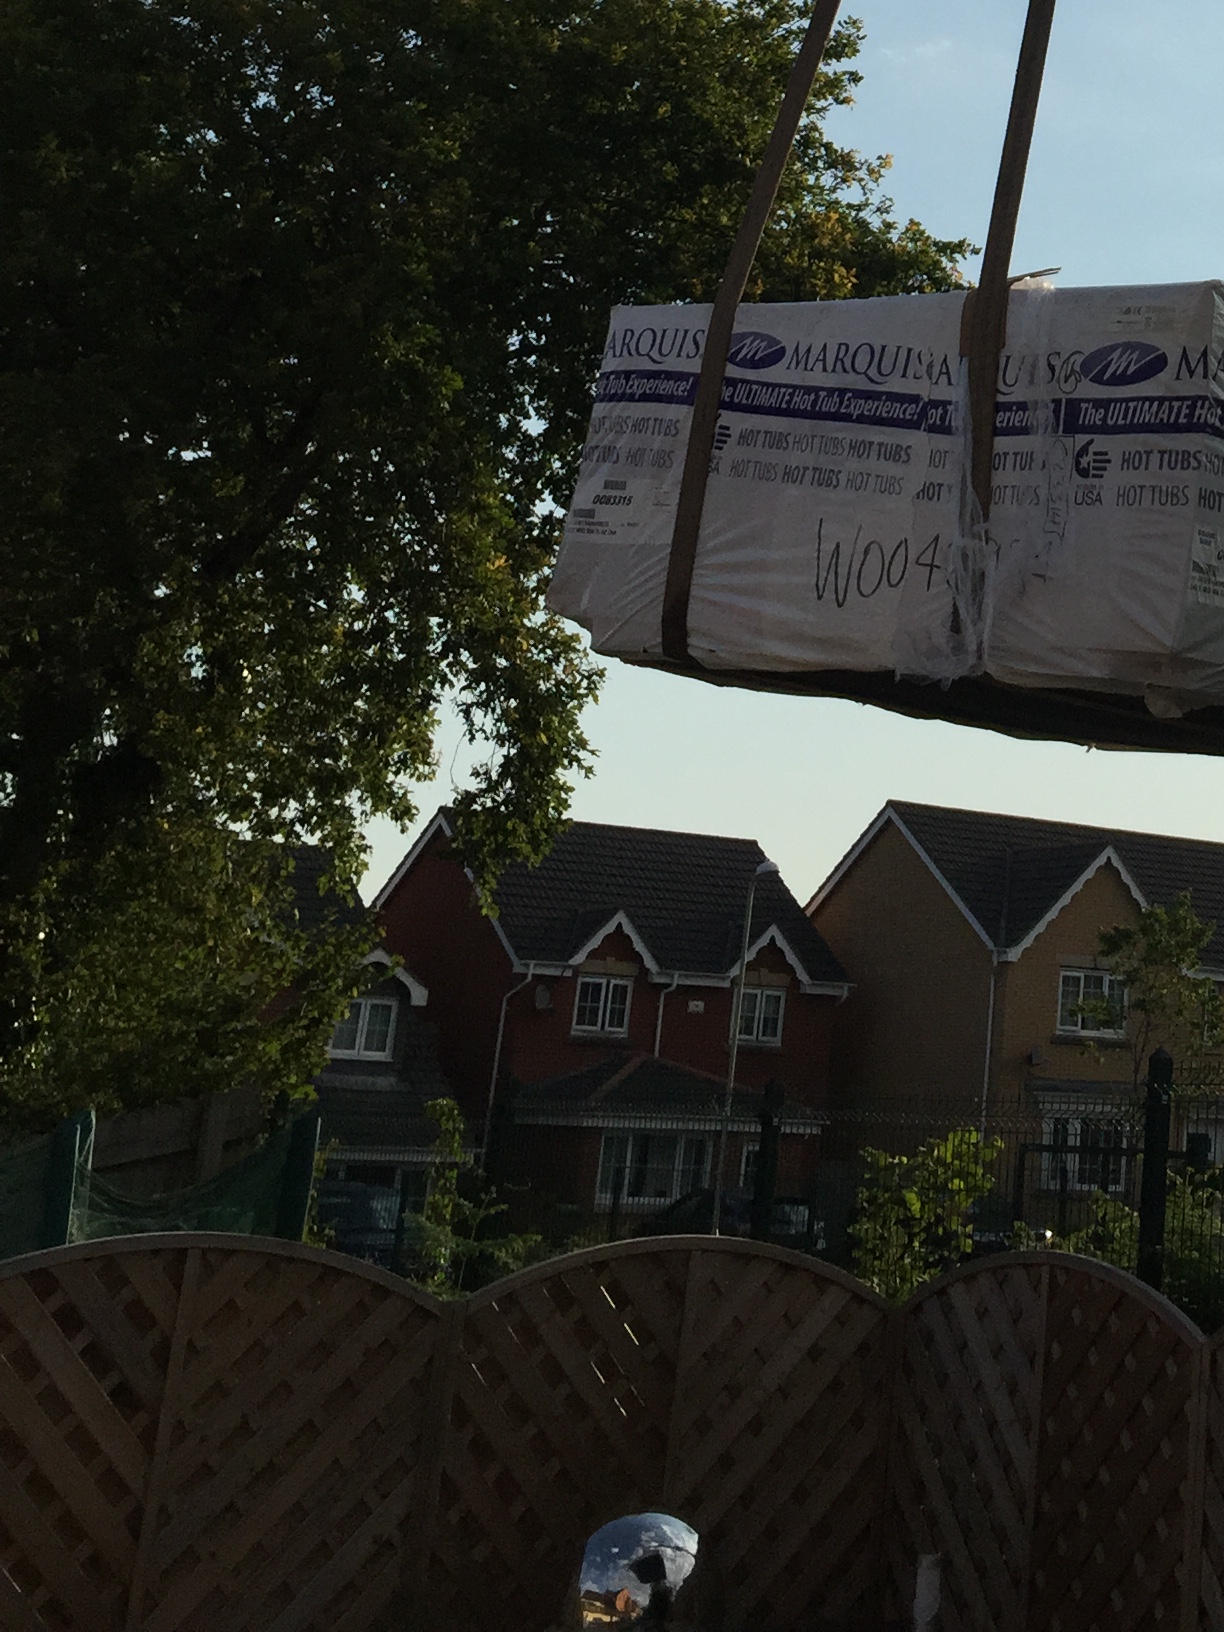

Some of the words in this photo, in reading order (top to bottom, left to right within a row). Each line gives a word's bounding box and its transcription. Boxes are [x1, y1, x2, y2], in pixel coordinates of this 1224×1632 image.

[603, 327, 705, 365] ARQUIS
[627, 373, 694, 400] Experience!
[733, 383, 790, 410] ULTIMATE
[790, 391, 812, 411] Hot
[816, 391, 840, 413] Tub
[841, 392, 922, 421] Experience!
[1077, 402, 1104, 425] The
[1106, 400, 1190, 426] ULTIMATE
[1192, 399, 1222, 428] Hot
[738, 428, 761, 448] HOT
[759, 429, 789, 450] TUBS
[792, 432, 818, 452] HOT
[818, 435, 847, 456] TUBS
[849, 440, 877, 461] HOT
[877, 441, 912, 464] TUBS
[1120, 449, 1153, 471] HOT
[1156, 448, 1203, 471] TUBS
[729, 459, 753, 478] HOT
[751, 460, 779, 482] TUBS
[781, 464, 808, 486] HOT
[807, 466, 842, 490] TUBS
[845, 470, 870, 492] HOT
[868, 472, 904, 495] TUBS
[1074, 490, 1104, 506] USA
[1116, 485, 1144, 507] HOT
[1146, 484, 1189, 506] TUBS
[1198, 486, 1224, 513] HOT
